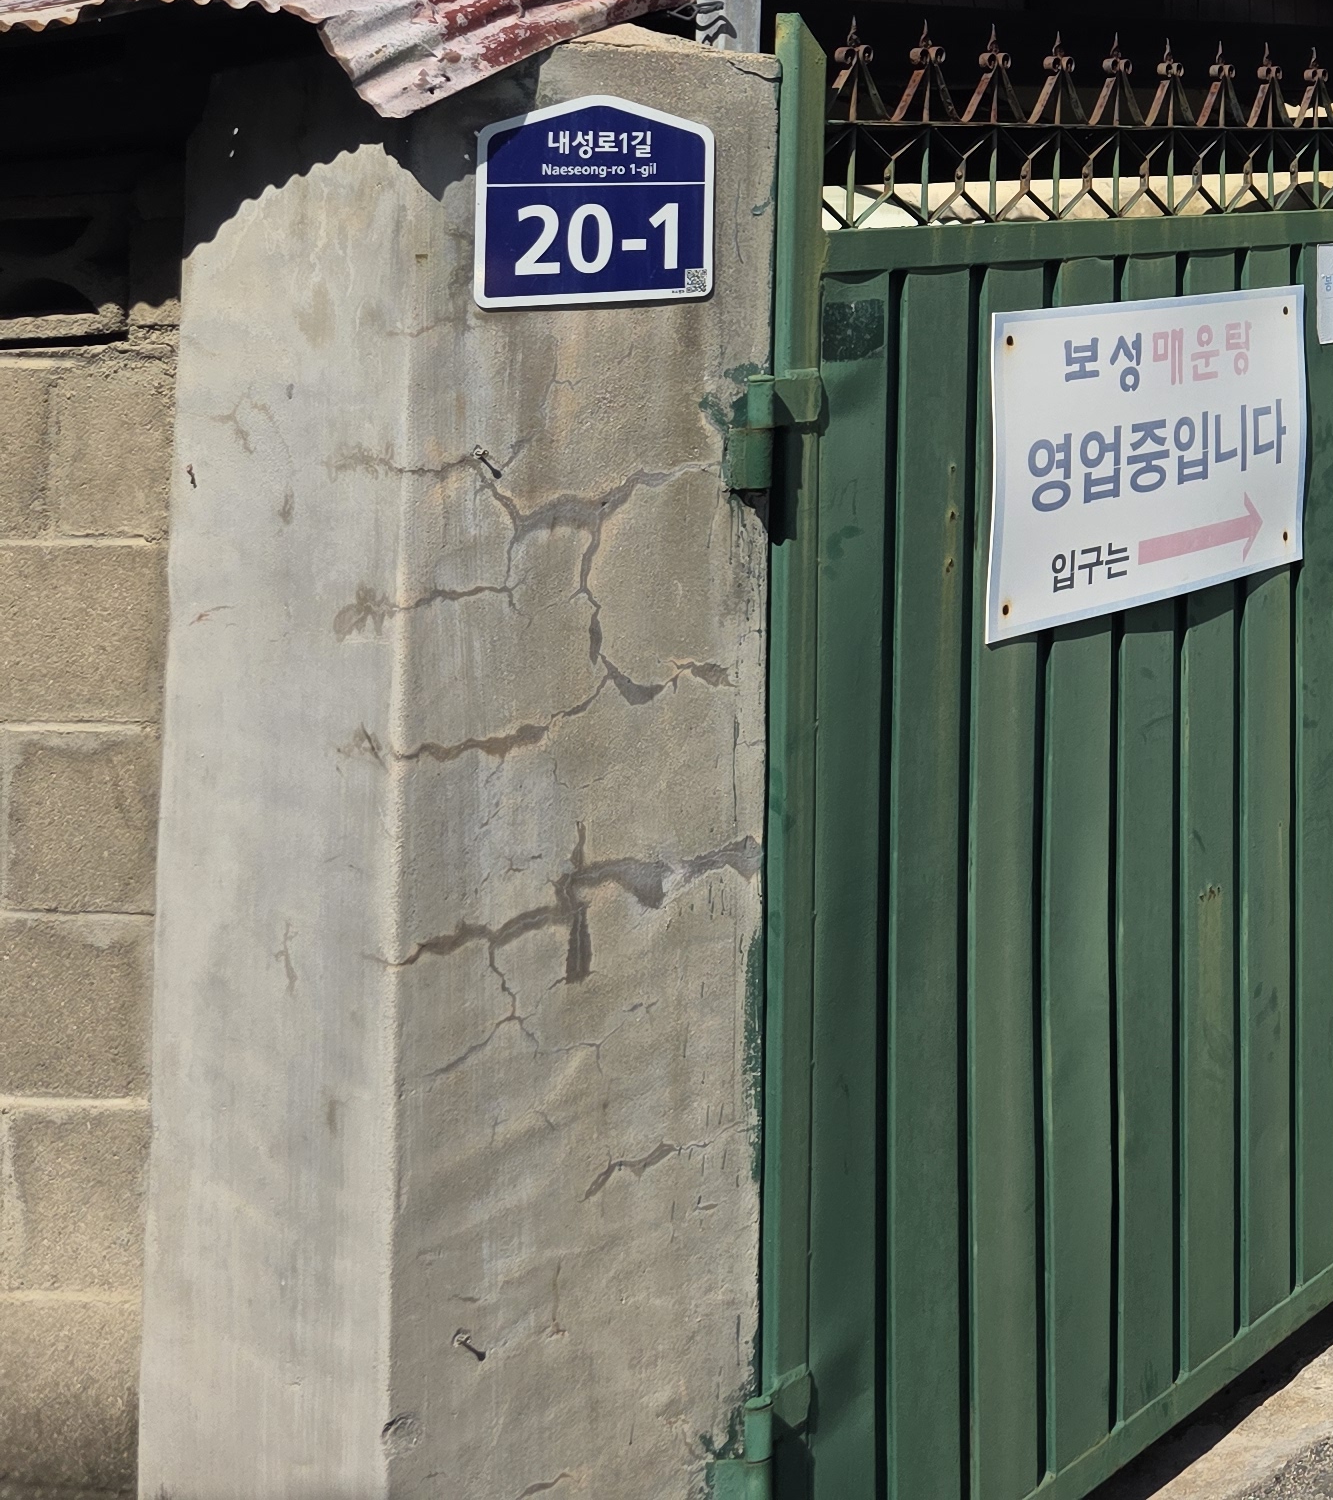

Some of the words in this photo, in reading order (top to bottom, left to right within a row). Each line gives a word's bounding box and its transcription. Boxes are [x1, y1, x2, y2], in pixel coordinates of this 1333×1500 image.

[541, 163, 626, 178] Naeseong-ro
[629, 162, 657, 178] 1-gil
[547, 130, 653, 159] 내성로1길
[514, 202, 680, 276] 20-1
[1063, 319, 1253, 393] 보성매운탕
[1027, 397, 1287, 513] 영업중입니다
[1051, 542, 1130, 593] 입구는
